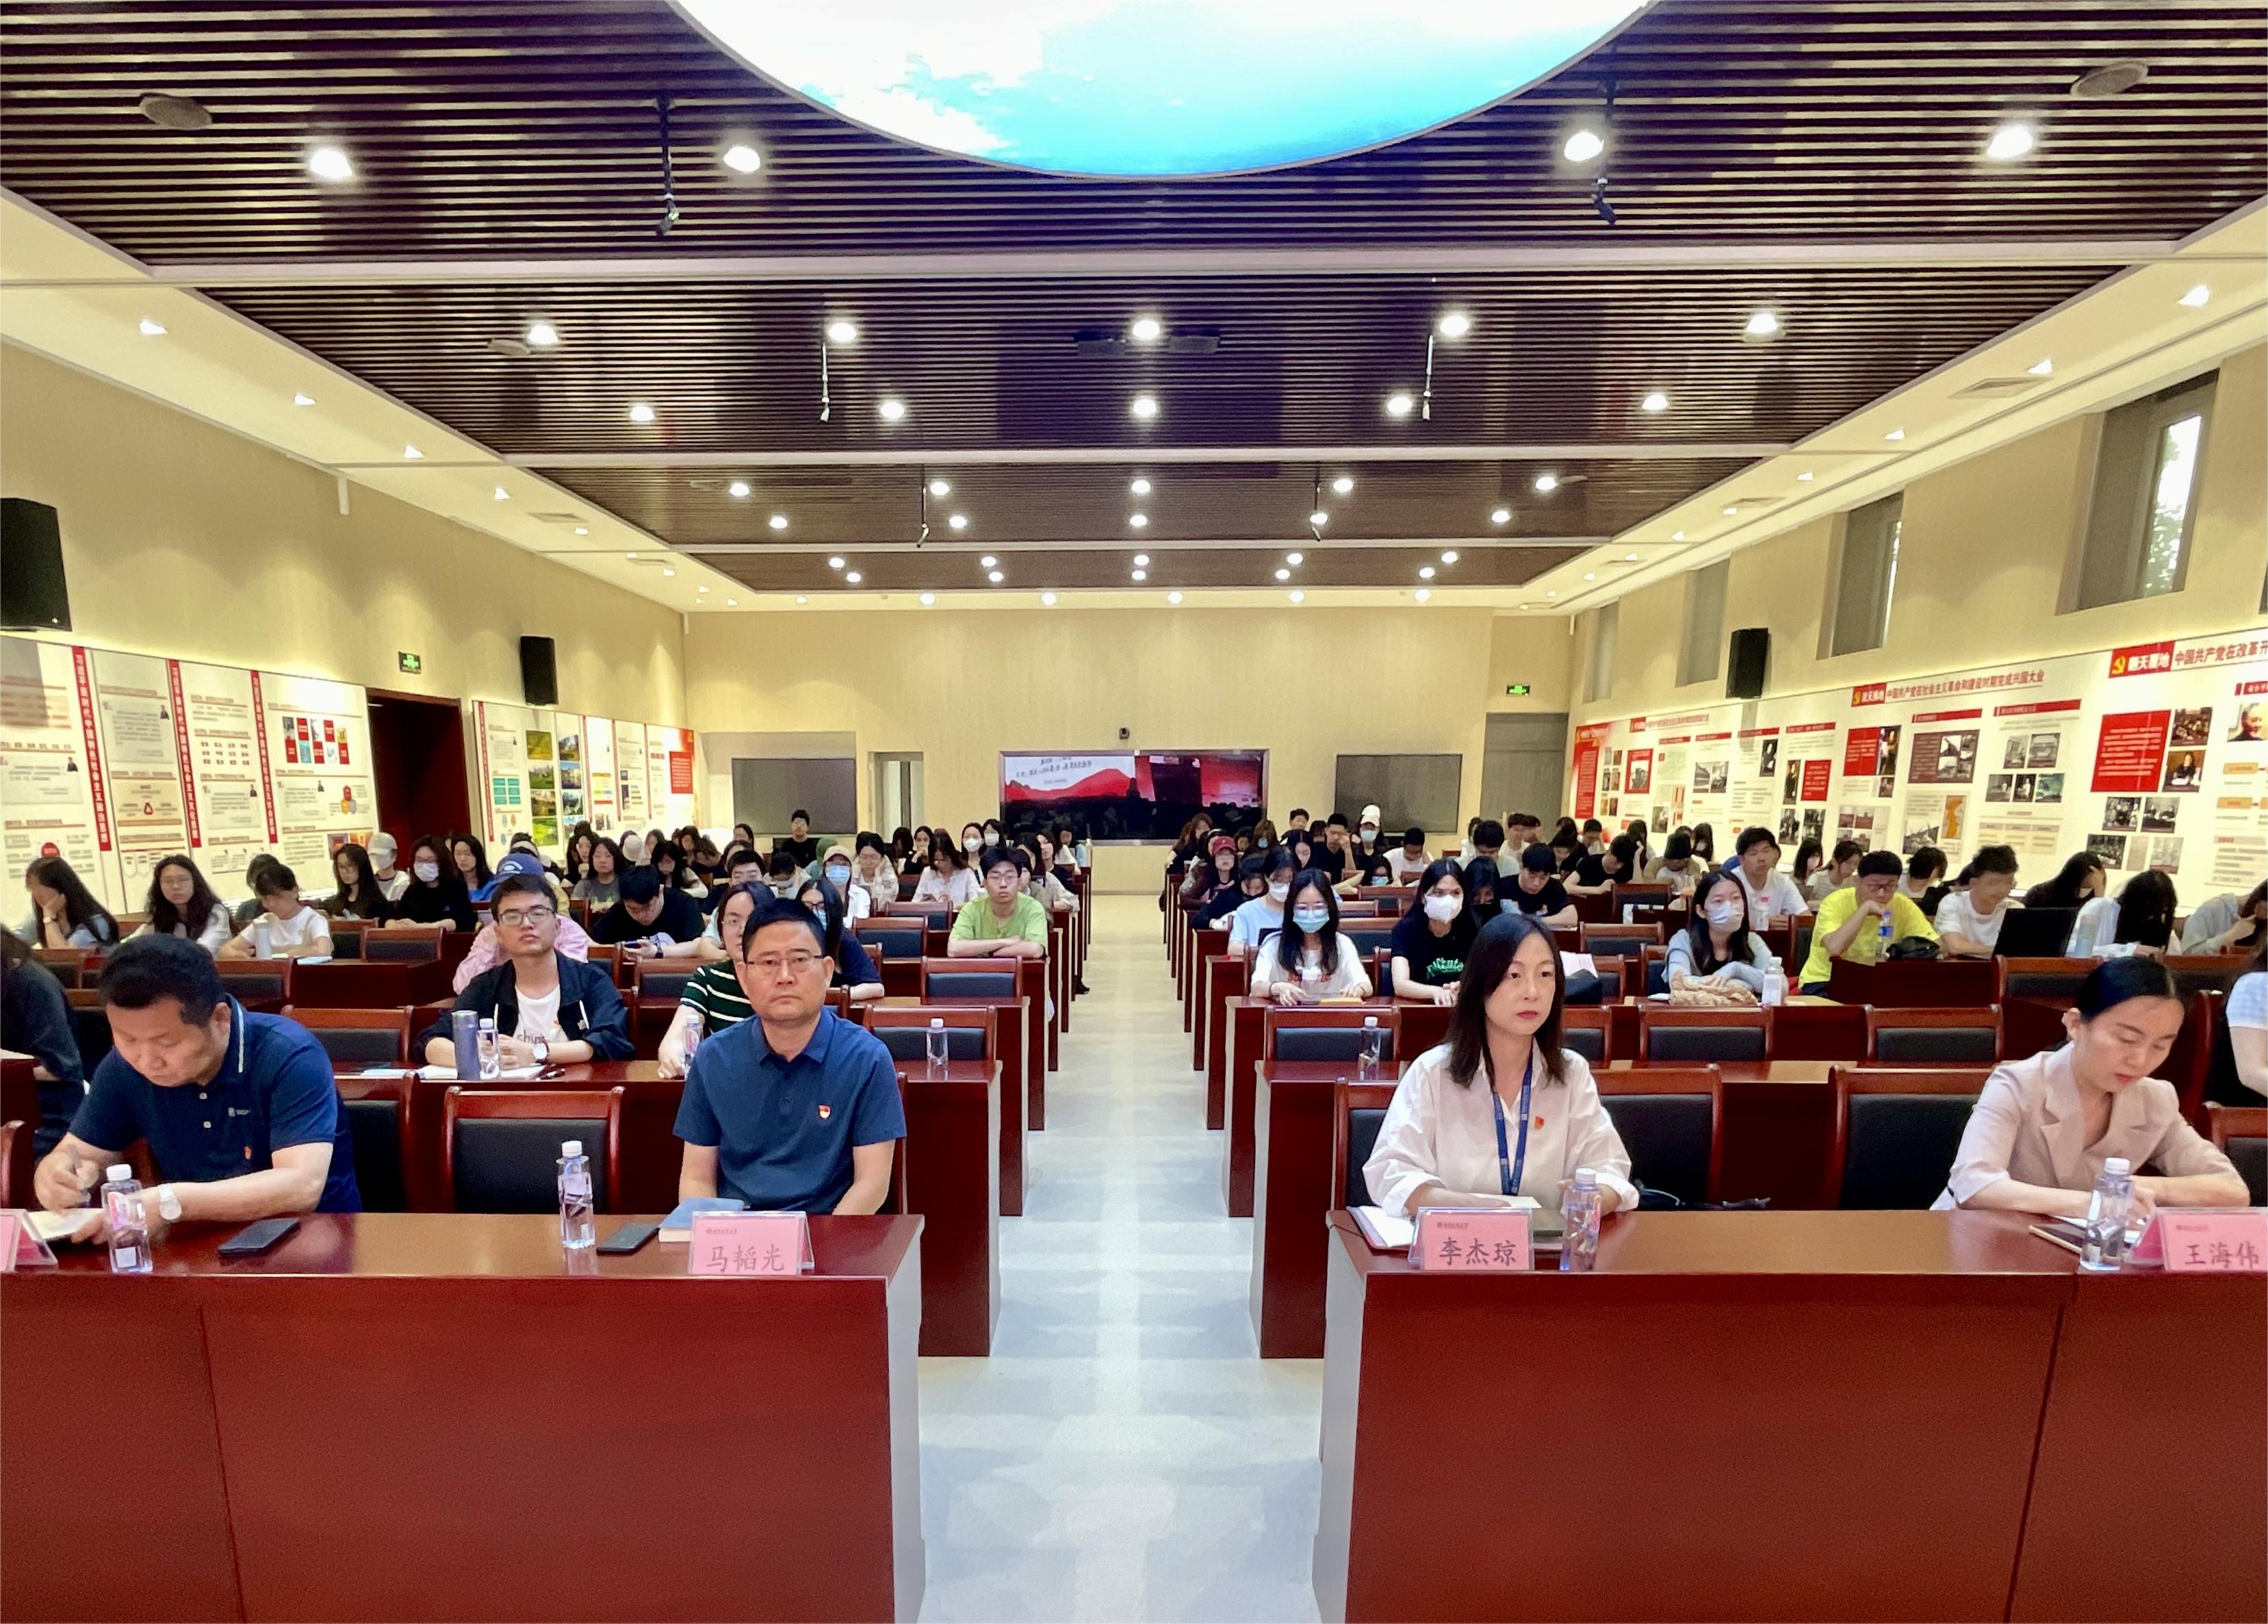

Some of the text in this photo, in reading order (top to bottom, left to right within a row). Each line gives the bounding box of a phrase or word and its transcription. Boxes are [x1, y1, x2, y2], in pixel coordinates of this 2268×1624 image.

[707, 1244, 784, 1273] 马韬光
[1439, 1237, 1517, 1266] 李杰琼
[2185, 1241, 2259, 1269] 王海伟
